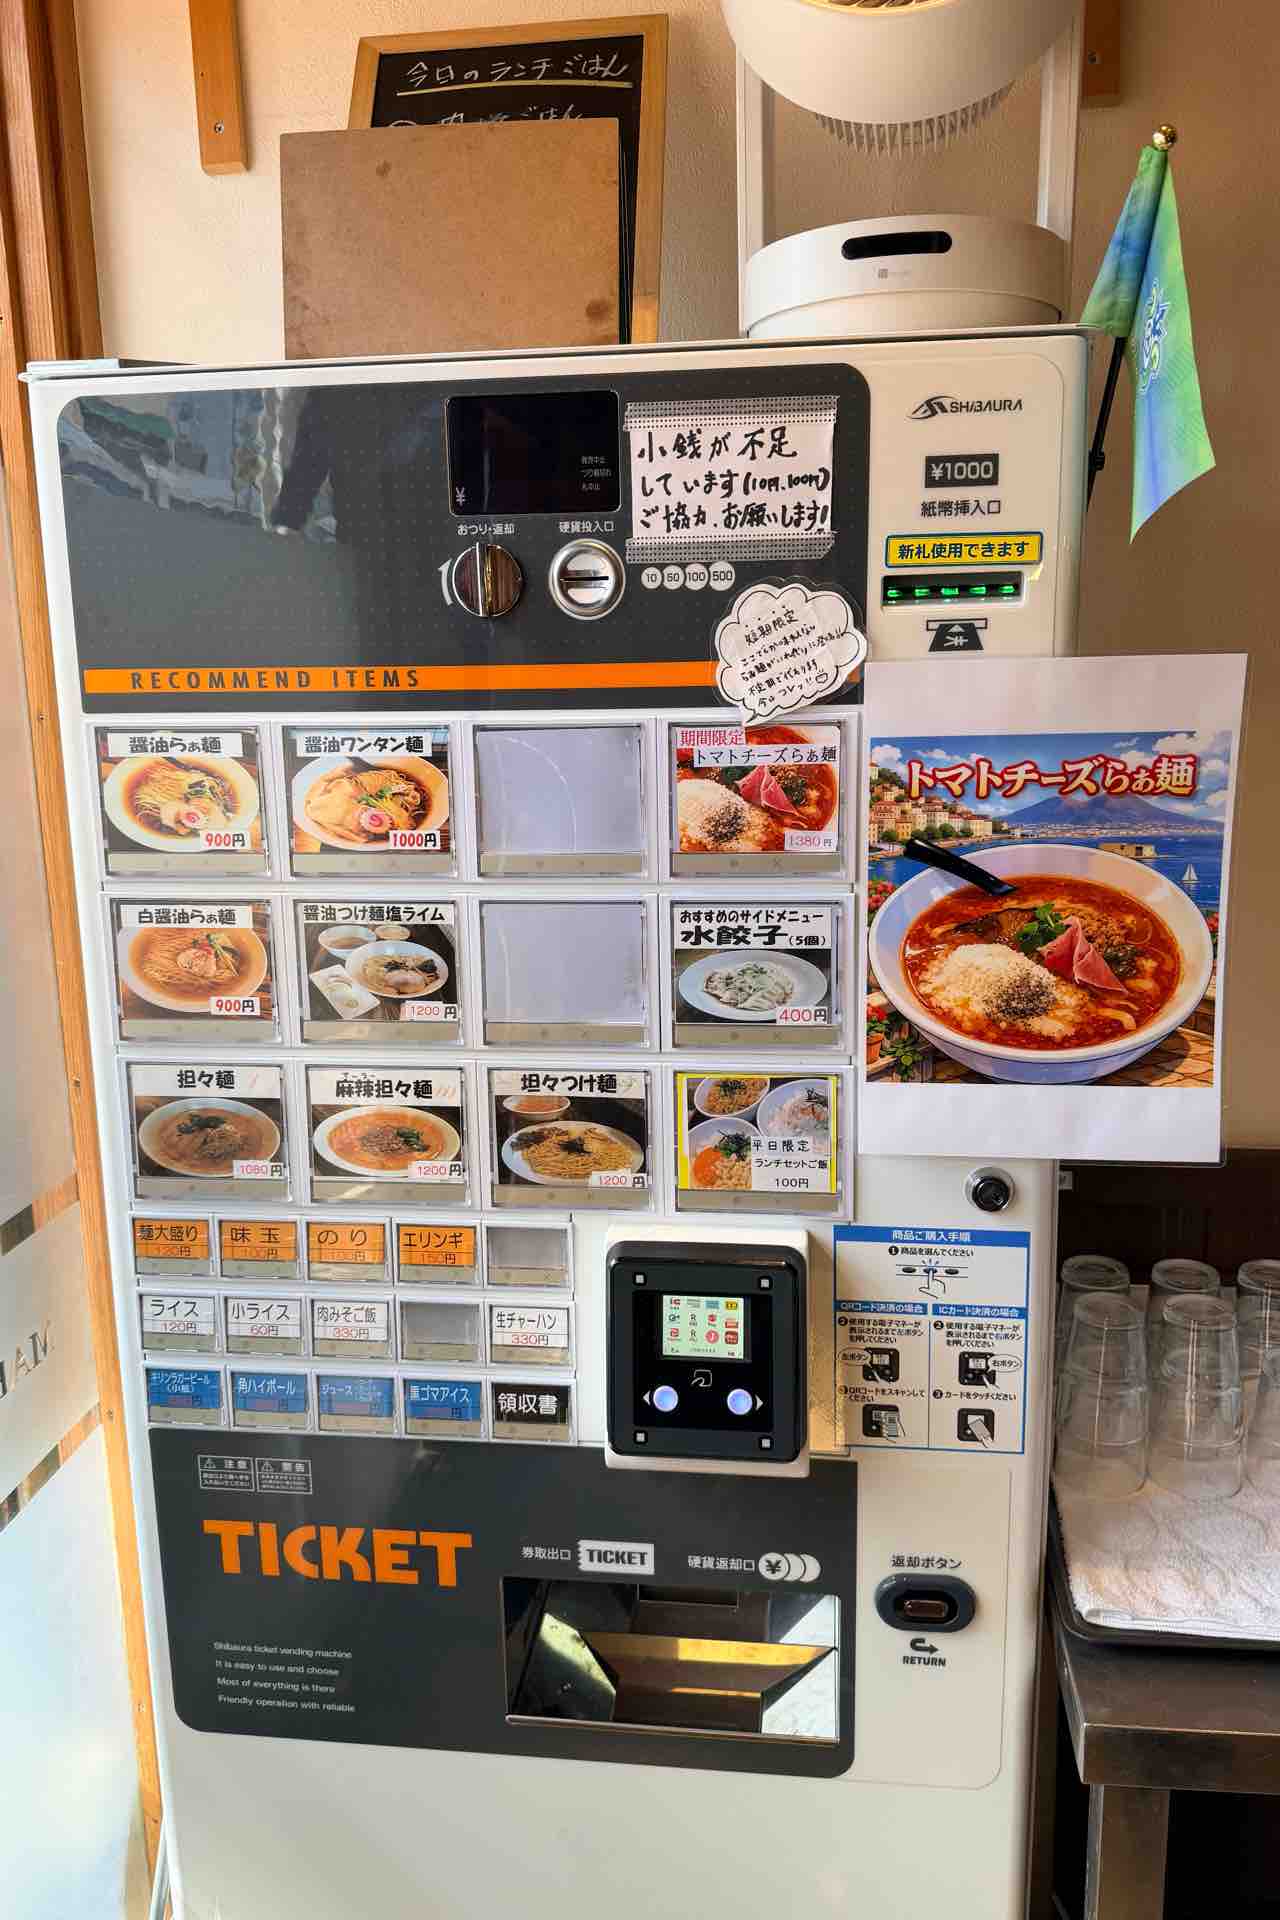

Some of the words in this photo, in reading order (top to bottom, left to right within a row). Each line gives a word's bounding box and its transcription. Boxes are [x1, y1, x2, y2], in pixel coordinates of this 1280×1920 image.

[950, 399, 1023, 413] SHIBAURA
[638, 426, 798, 462] 小銭が不足
[931, 461, 993, 481] ¥1000
[920, 500, 1001, 518] 紙幣挿入口
[897, 541, 1030, 560] 新札使用できます
[646, 572, 658, 582] 10
[666, 571, 680, 582] 50
[687, 570, 706, 582] 100
[712, 569, 733, 582] 500
[131, 670, 311, 690] RECOMMEND
[332, 668, 419, 688] ITEMS
[129, 736, 222, 754] 醤油らぁ麺
[305, 735, 424, 753] 醤油ワンタン麺
[680, 729, 744, 746] 期間限定
[697, 745, 837, 764] トマトチーズらぁ麺
[908, 755, 1196, 798] トマトチーズらぁ麺
[205, 832, 246, 847] 900円
[392, 832, 437, 847] 1000円
[138, 908, 237, 925] 白醤油らぁ麺
[303, 904, 446, 922] 醤油つけ麺塩ライム
[680, 910, 824, 924] おすすめのサイドメニュー
[215, 999, 255, 1013] 900円
[410, 1005, 457, 1019] 1200円
[779, 1008, 827, 1022] 400円
[752, 1139, 810, 1152] 平日限定
[417, 1163, 462, 1177] 1200円
[754, 1158, 828, 1170] ランチセットご飯
[775, 1177, 809, 1189] 100円
[230, 1226, 281, 1244] 味玉
[317, 1229, 367, 1246] のり
[402, 1231, 464, 1249] エリンギ
[892, 1230, 971, 1242] 商品ご購入手順
[151, 1299, 199, 1317] ライス
[232, 1302, 290, 1321] 小ライス
[495, 1311, 557, 1330] 生チャーハン
[511, 1335, 549, 1346] 330円
[498, 1393, 558, 1416] 領収書
[203, 1519, 473, 1587] TICKET
[585, 1548, 648, 1566] TICKET
[891, 1555, 962, 1569] 返却ボタン
[902, 1655, 946, 1666] RETURN
